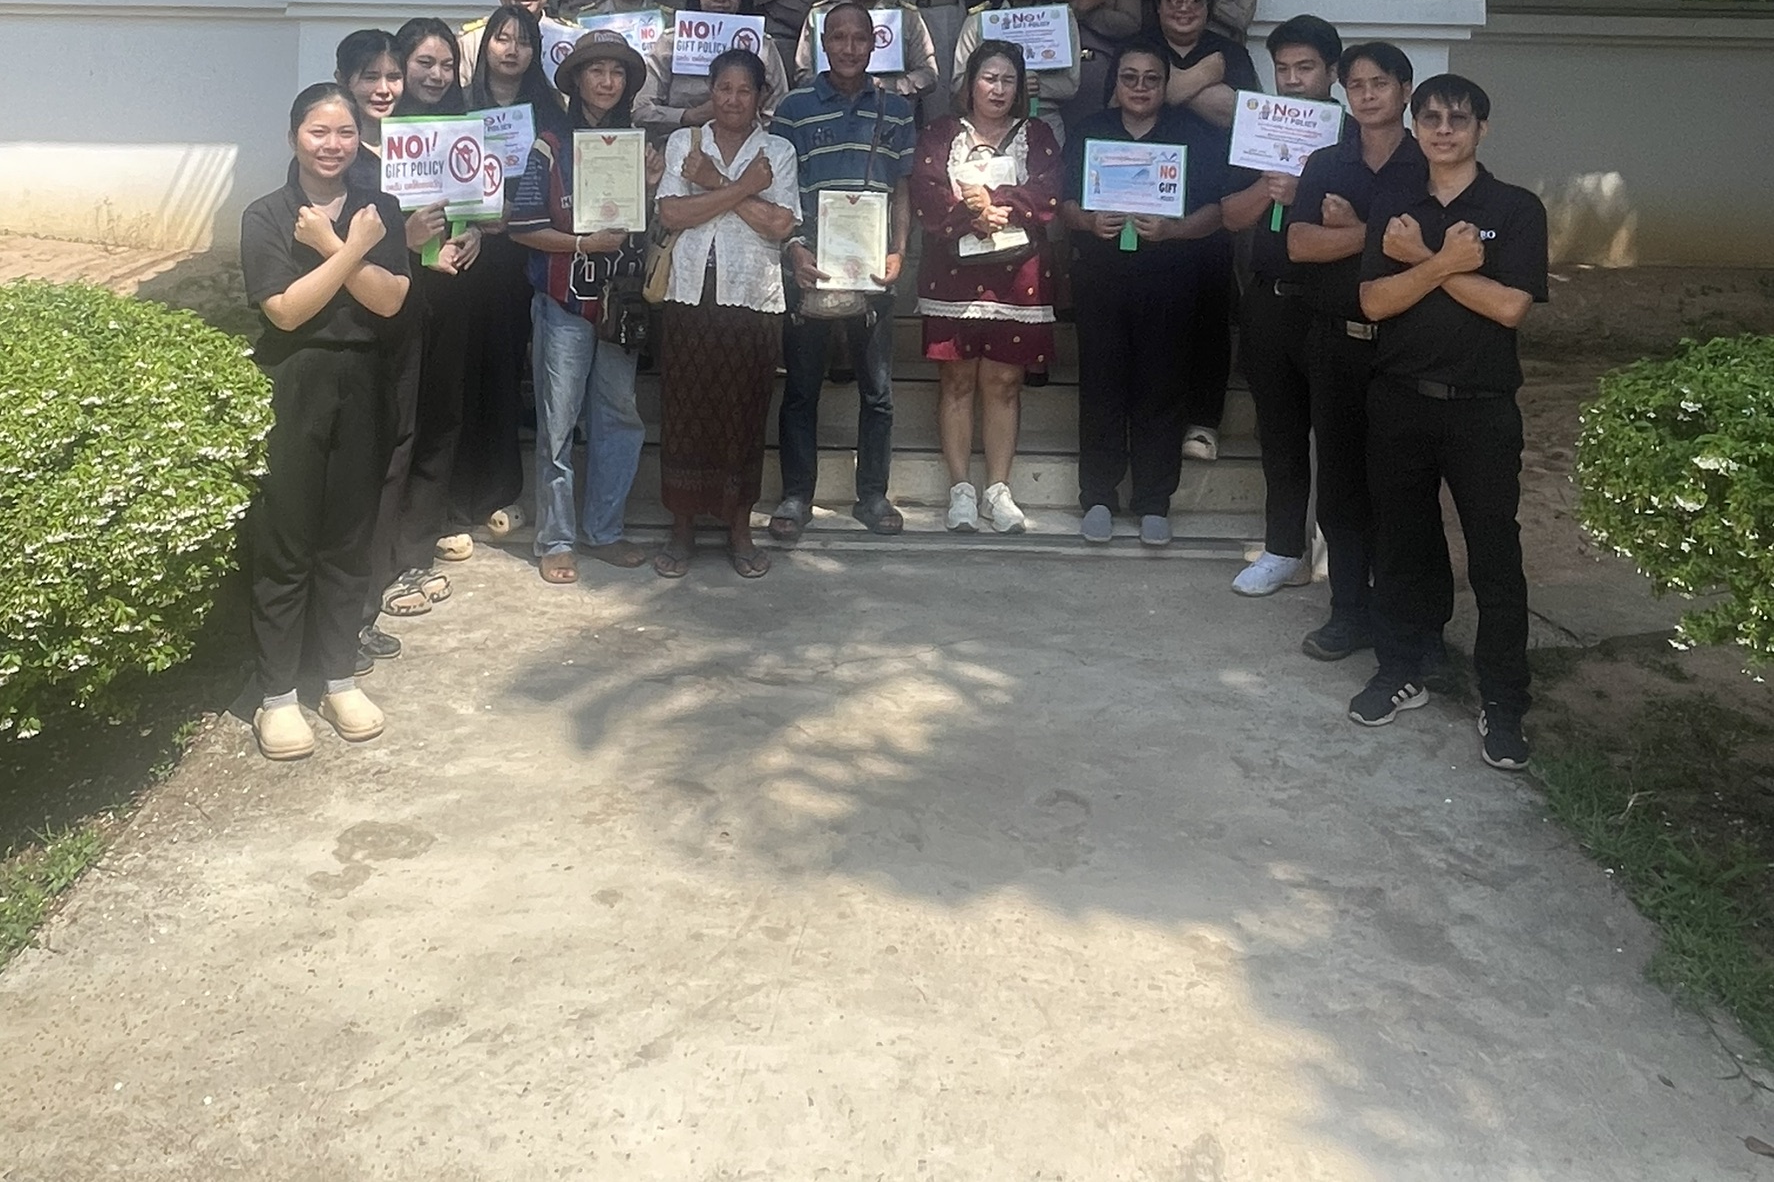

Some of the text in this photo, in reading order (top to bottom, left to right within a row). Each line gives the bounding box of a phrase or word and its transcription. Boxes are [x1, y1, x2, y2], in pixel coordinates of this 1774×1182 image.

[641, 27, 655, 40] NO
[676, 40, 727, 55] GIFT POLICY
[385, 159, 445, 179] GIFT POLICY
[1159, 165, 1177, 180] NO
[1159, 182, 1178, 194] GIFT
